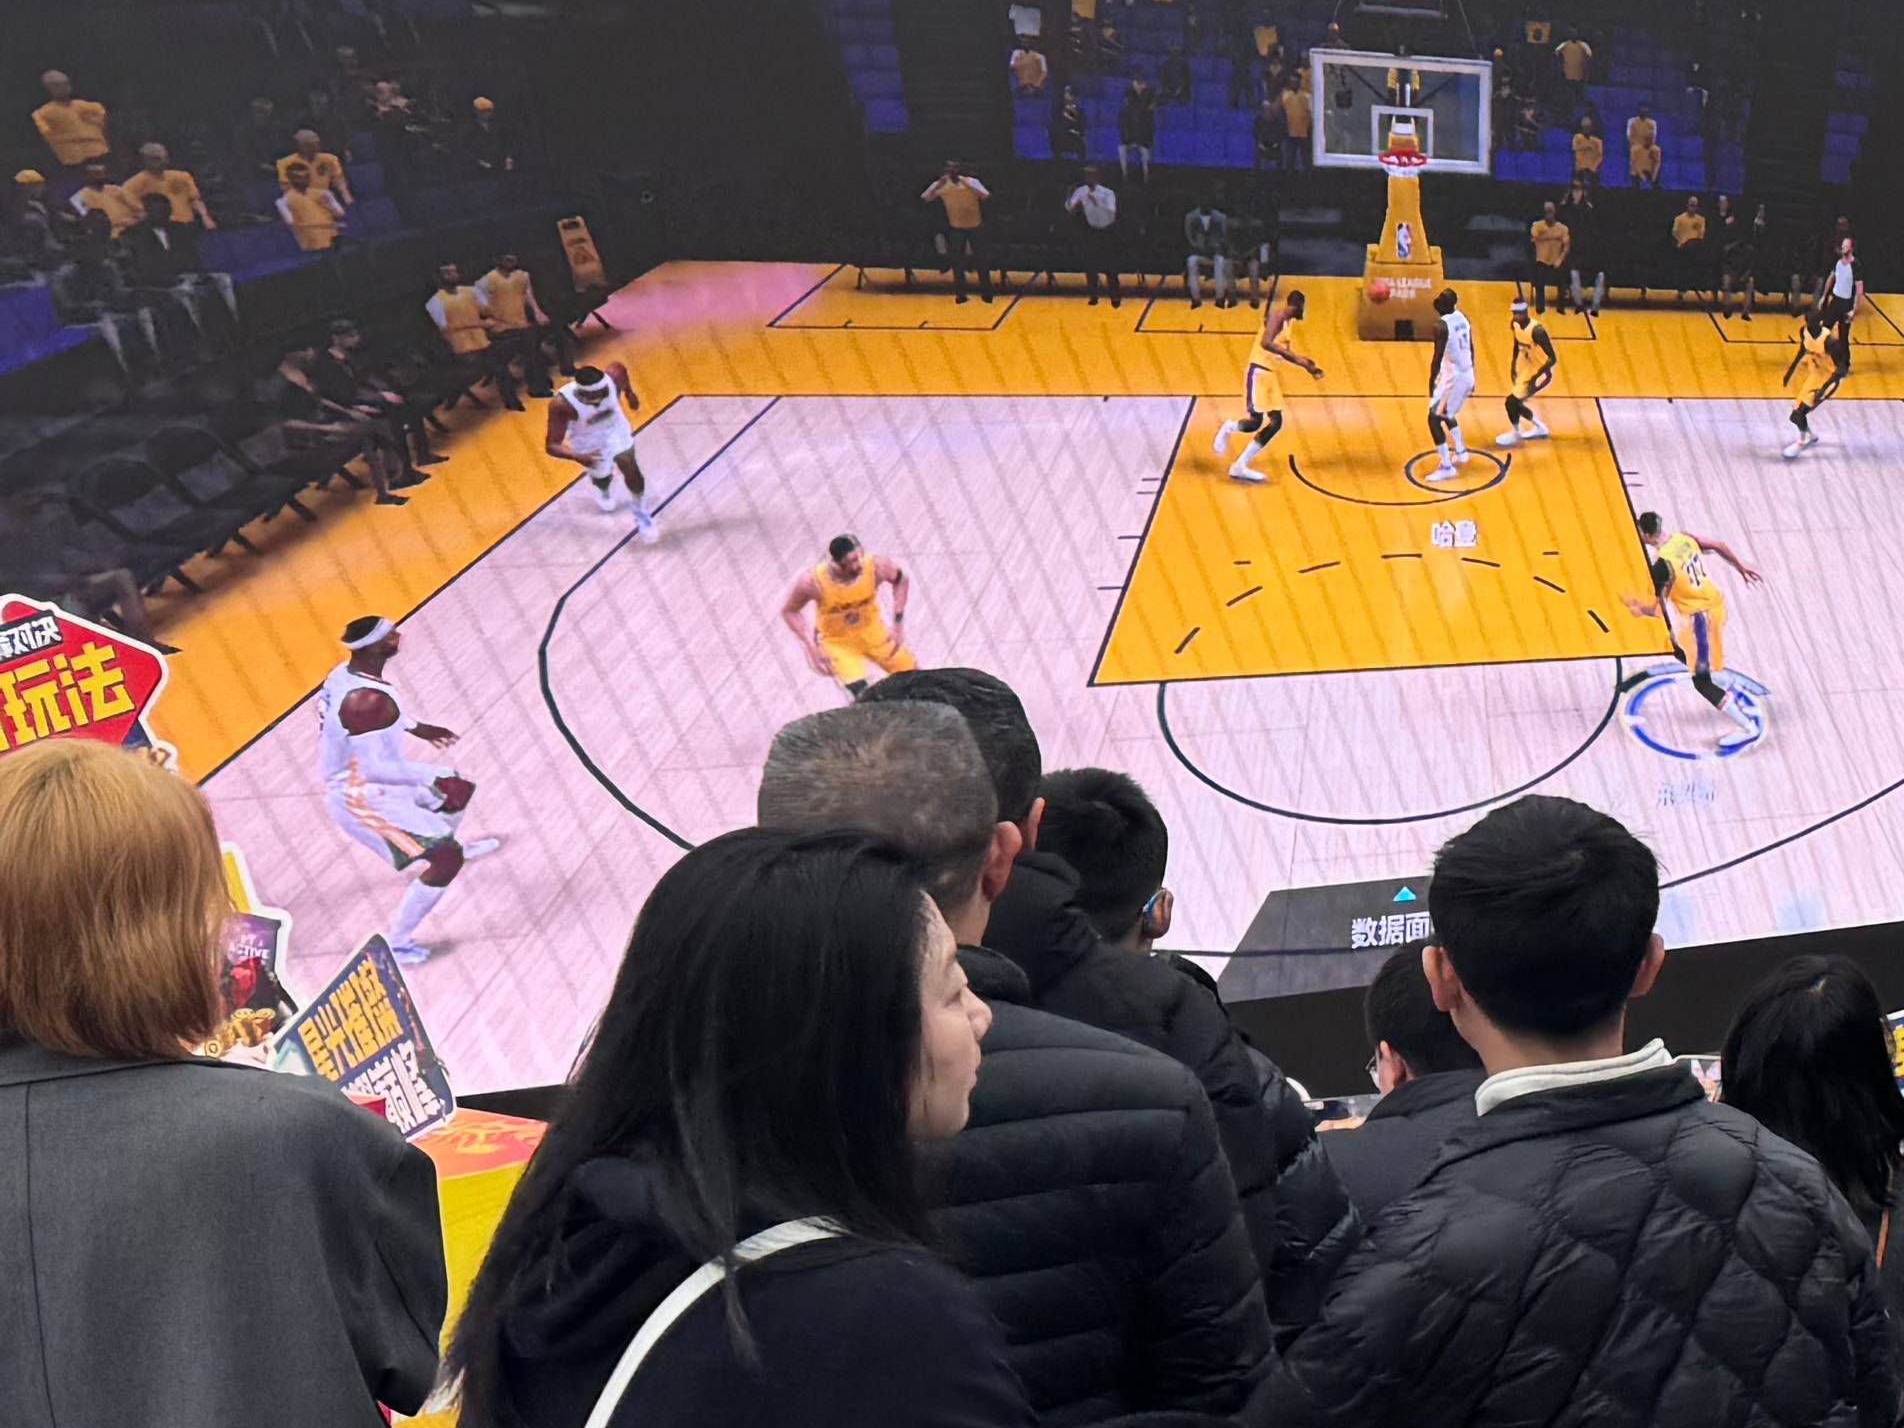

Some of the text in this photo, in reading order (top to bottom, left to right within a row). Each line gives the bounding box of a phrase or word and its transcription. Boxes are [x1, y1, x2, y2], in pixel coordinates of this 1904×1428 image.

[0, 641, 136, 752] 玩法
[1351, 911, 1434, 949] 数据面
